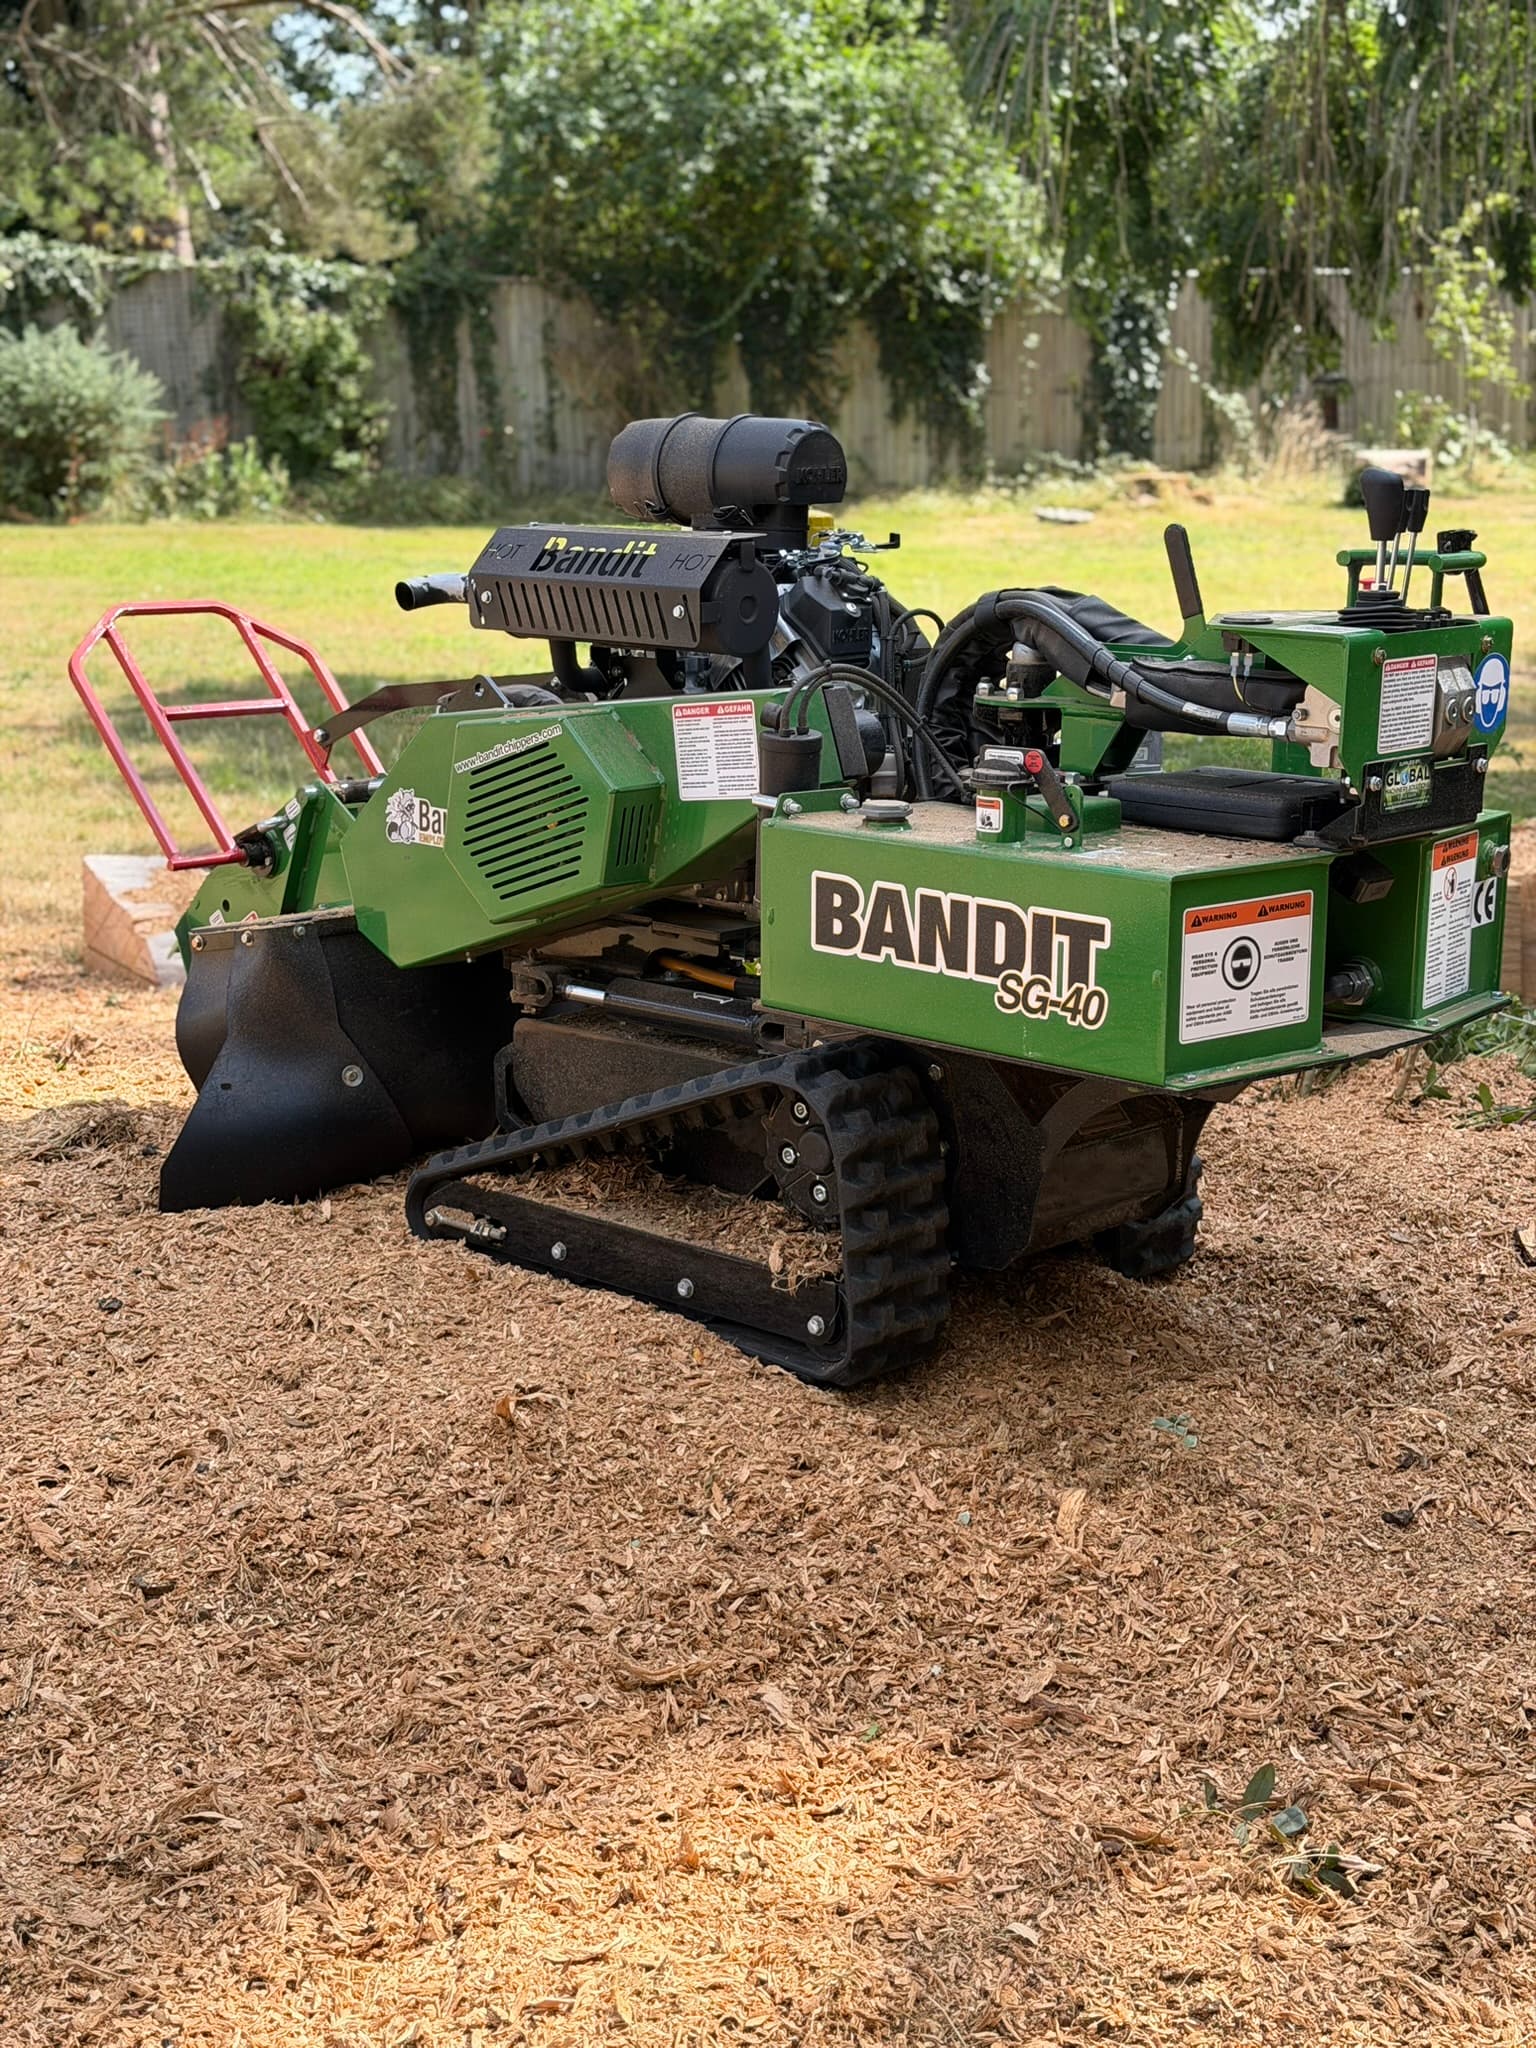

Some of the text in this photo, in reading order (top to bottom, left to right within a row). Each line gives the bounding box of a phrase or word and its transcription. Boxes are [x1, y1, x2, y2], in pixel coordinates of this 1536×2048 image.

[482, 536, 717, 578] HOT Bandit HOT
[1391, 661, 1409, 670] DANGER
[682, 704, 752, 715] DANGER GEFAHR
[454, 724, 562, 771] www.banditchippers.com
[1386, 766, 1430, 787] GLOBAL
[1202, 900, 1305, 923] WARNING WARNUNG
[813, 874, 1108, 988] BANDIT
[996, 972, 1107, 1028] SG-40
